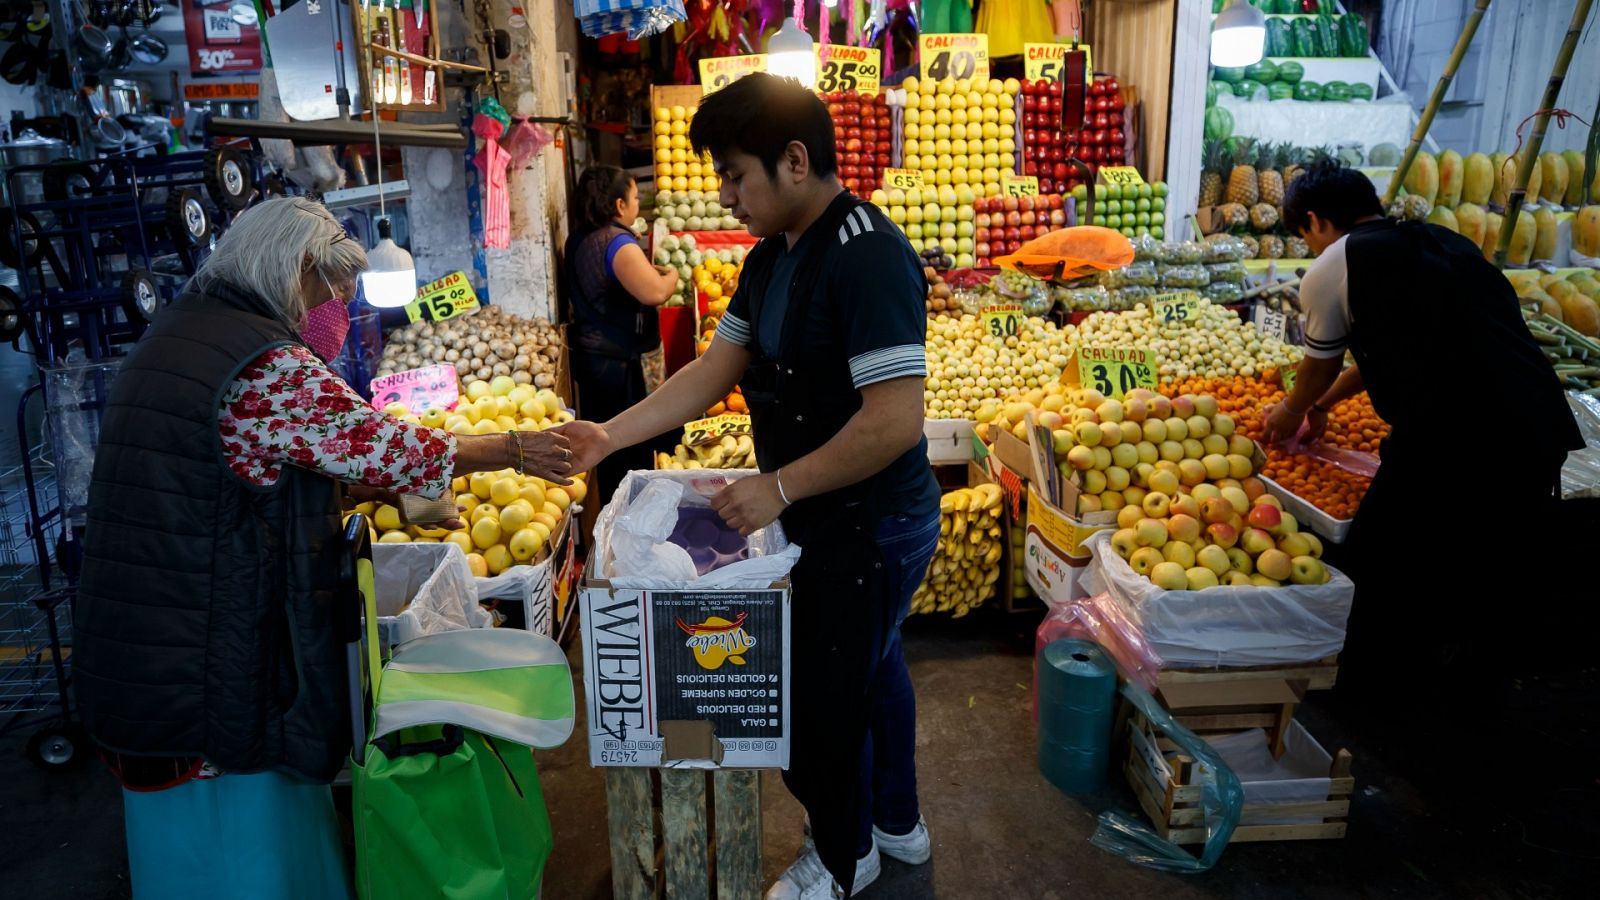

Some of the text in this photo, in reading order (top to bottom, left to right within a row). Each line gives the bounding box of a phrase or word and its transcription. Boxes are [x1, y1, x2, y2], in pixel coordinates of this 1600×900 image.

[1082, 347, 1146, 363] CALIDAD
[686, 627, 757, 656] Wiebe
[593, 596, 645, 729] WIEBE
[676, 674, 767, 683] GOLDEN DELICIOUS
[681, 689, 767, 698] GOLDEN SUPREME
[696, 705, 767, 713] RED DELICIOUS
[741, 718, 767, 727] GALA
[601, 750, 638, 762] 24579
